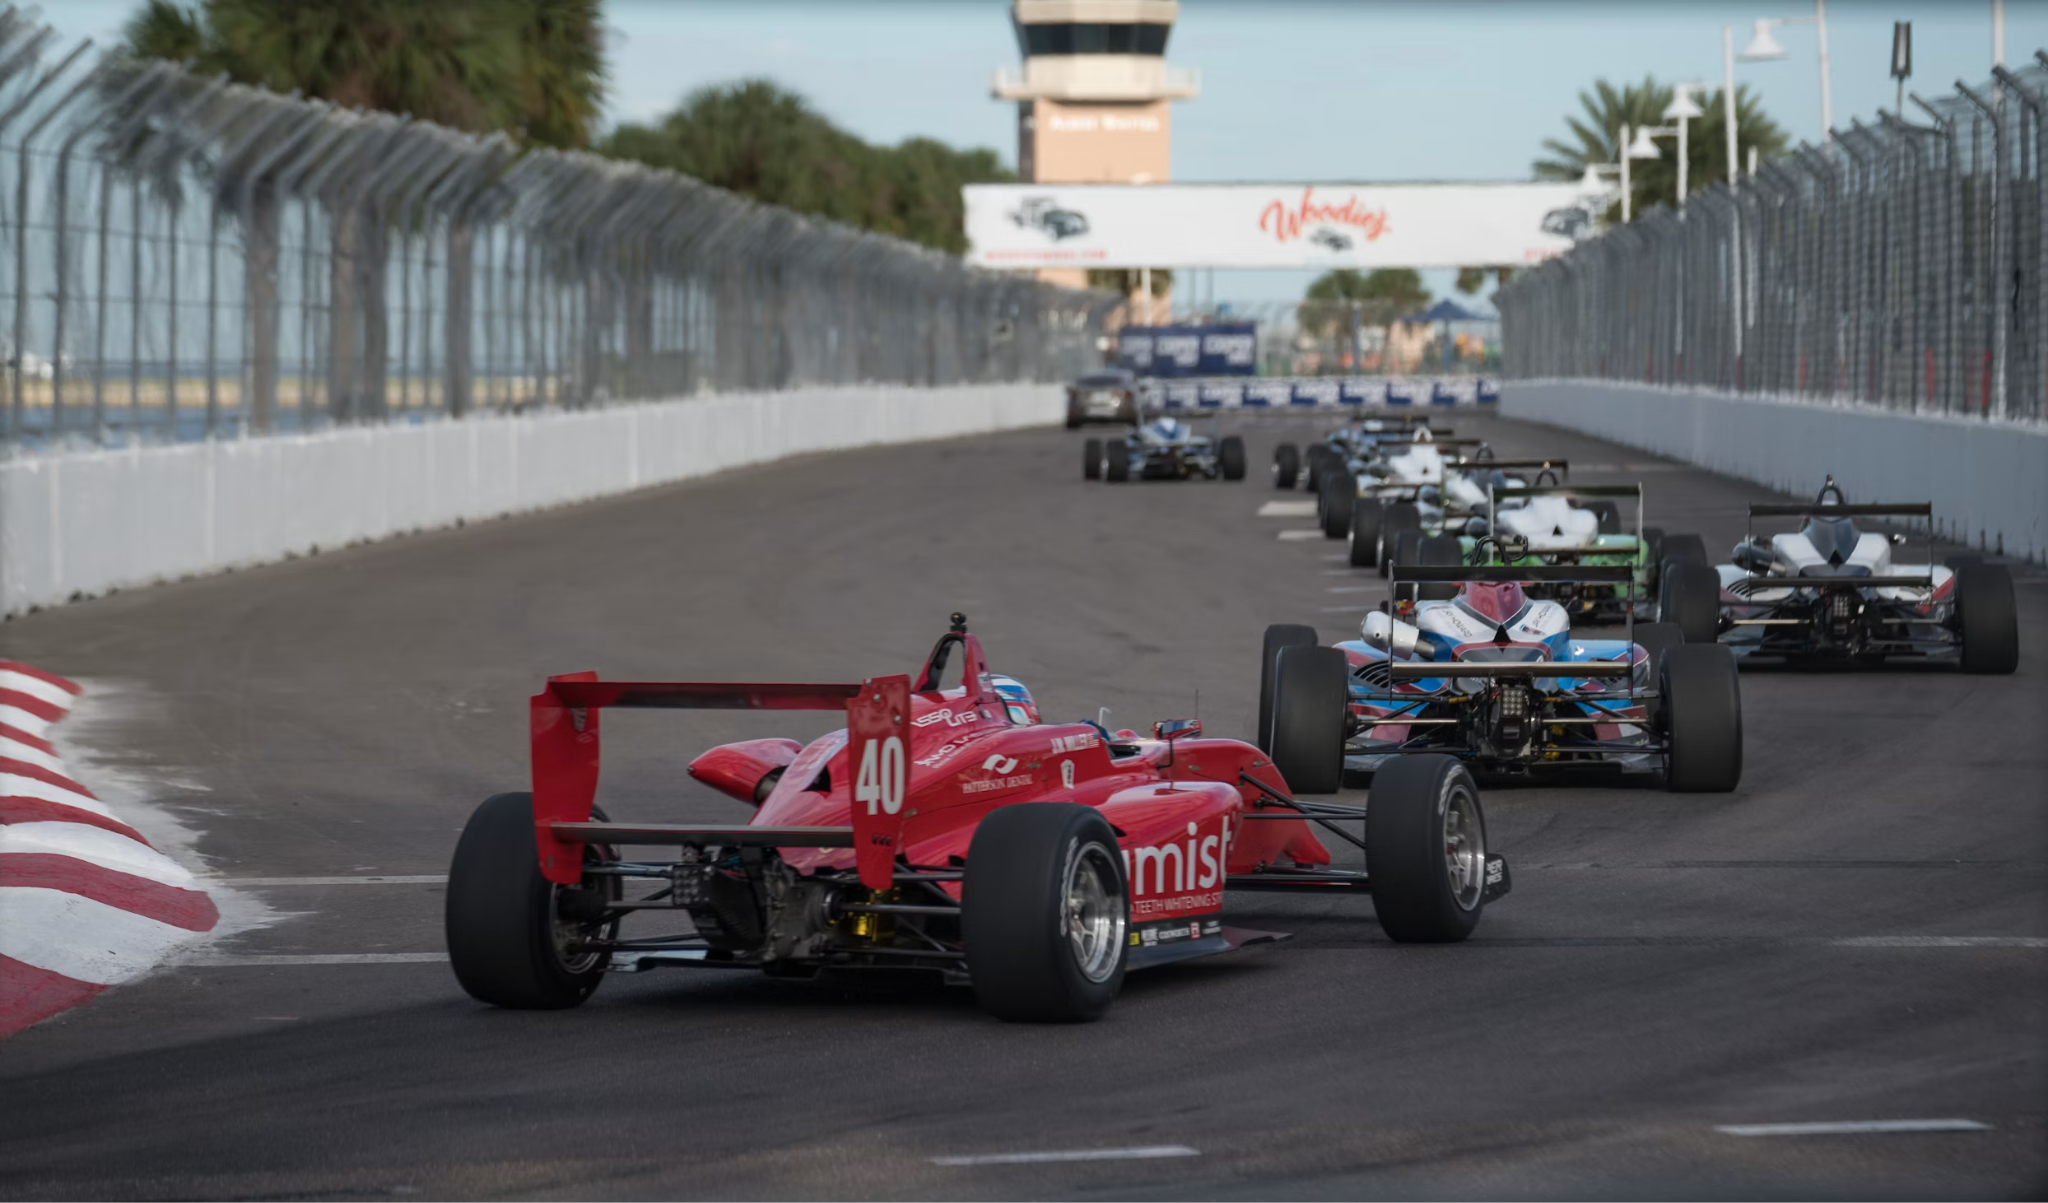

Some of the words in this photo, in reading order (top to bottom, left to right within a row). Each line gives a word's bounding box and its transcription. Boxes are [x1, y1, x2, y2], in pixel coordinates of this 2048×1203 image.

[856, 736, 905, 815] 40
[1134, 899, 1164, 914] TEETH
[1164, 894, 1211, 911] WHITENING
